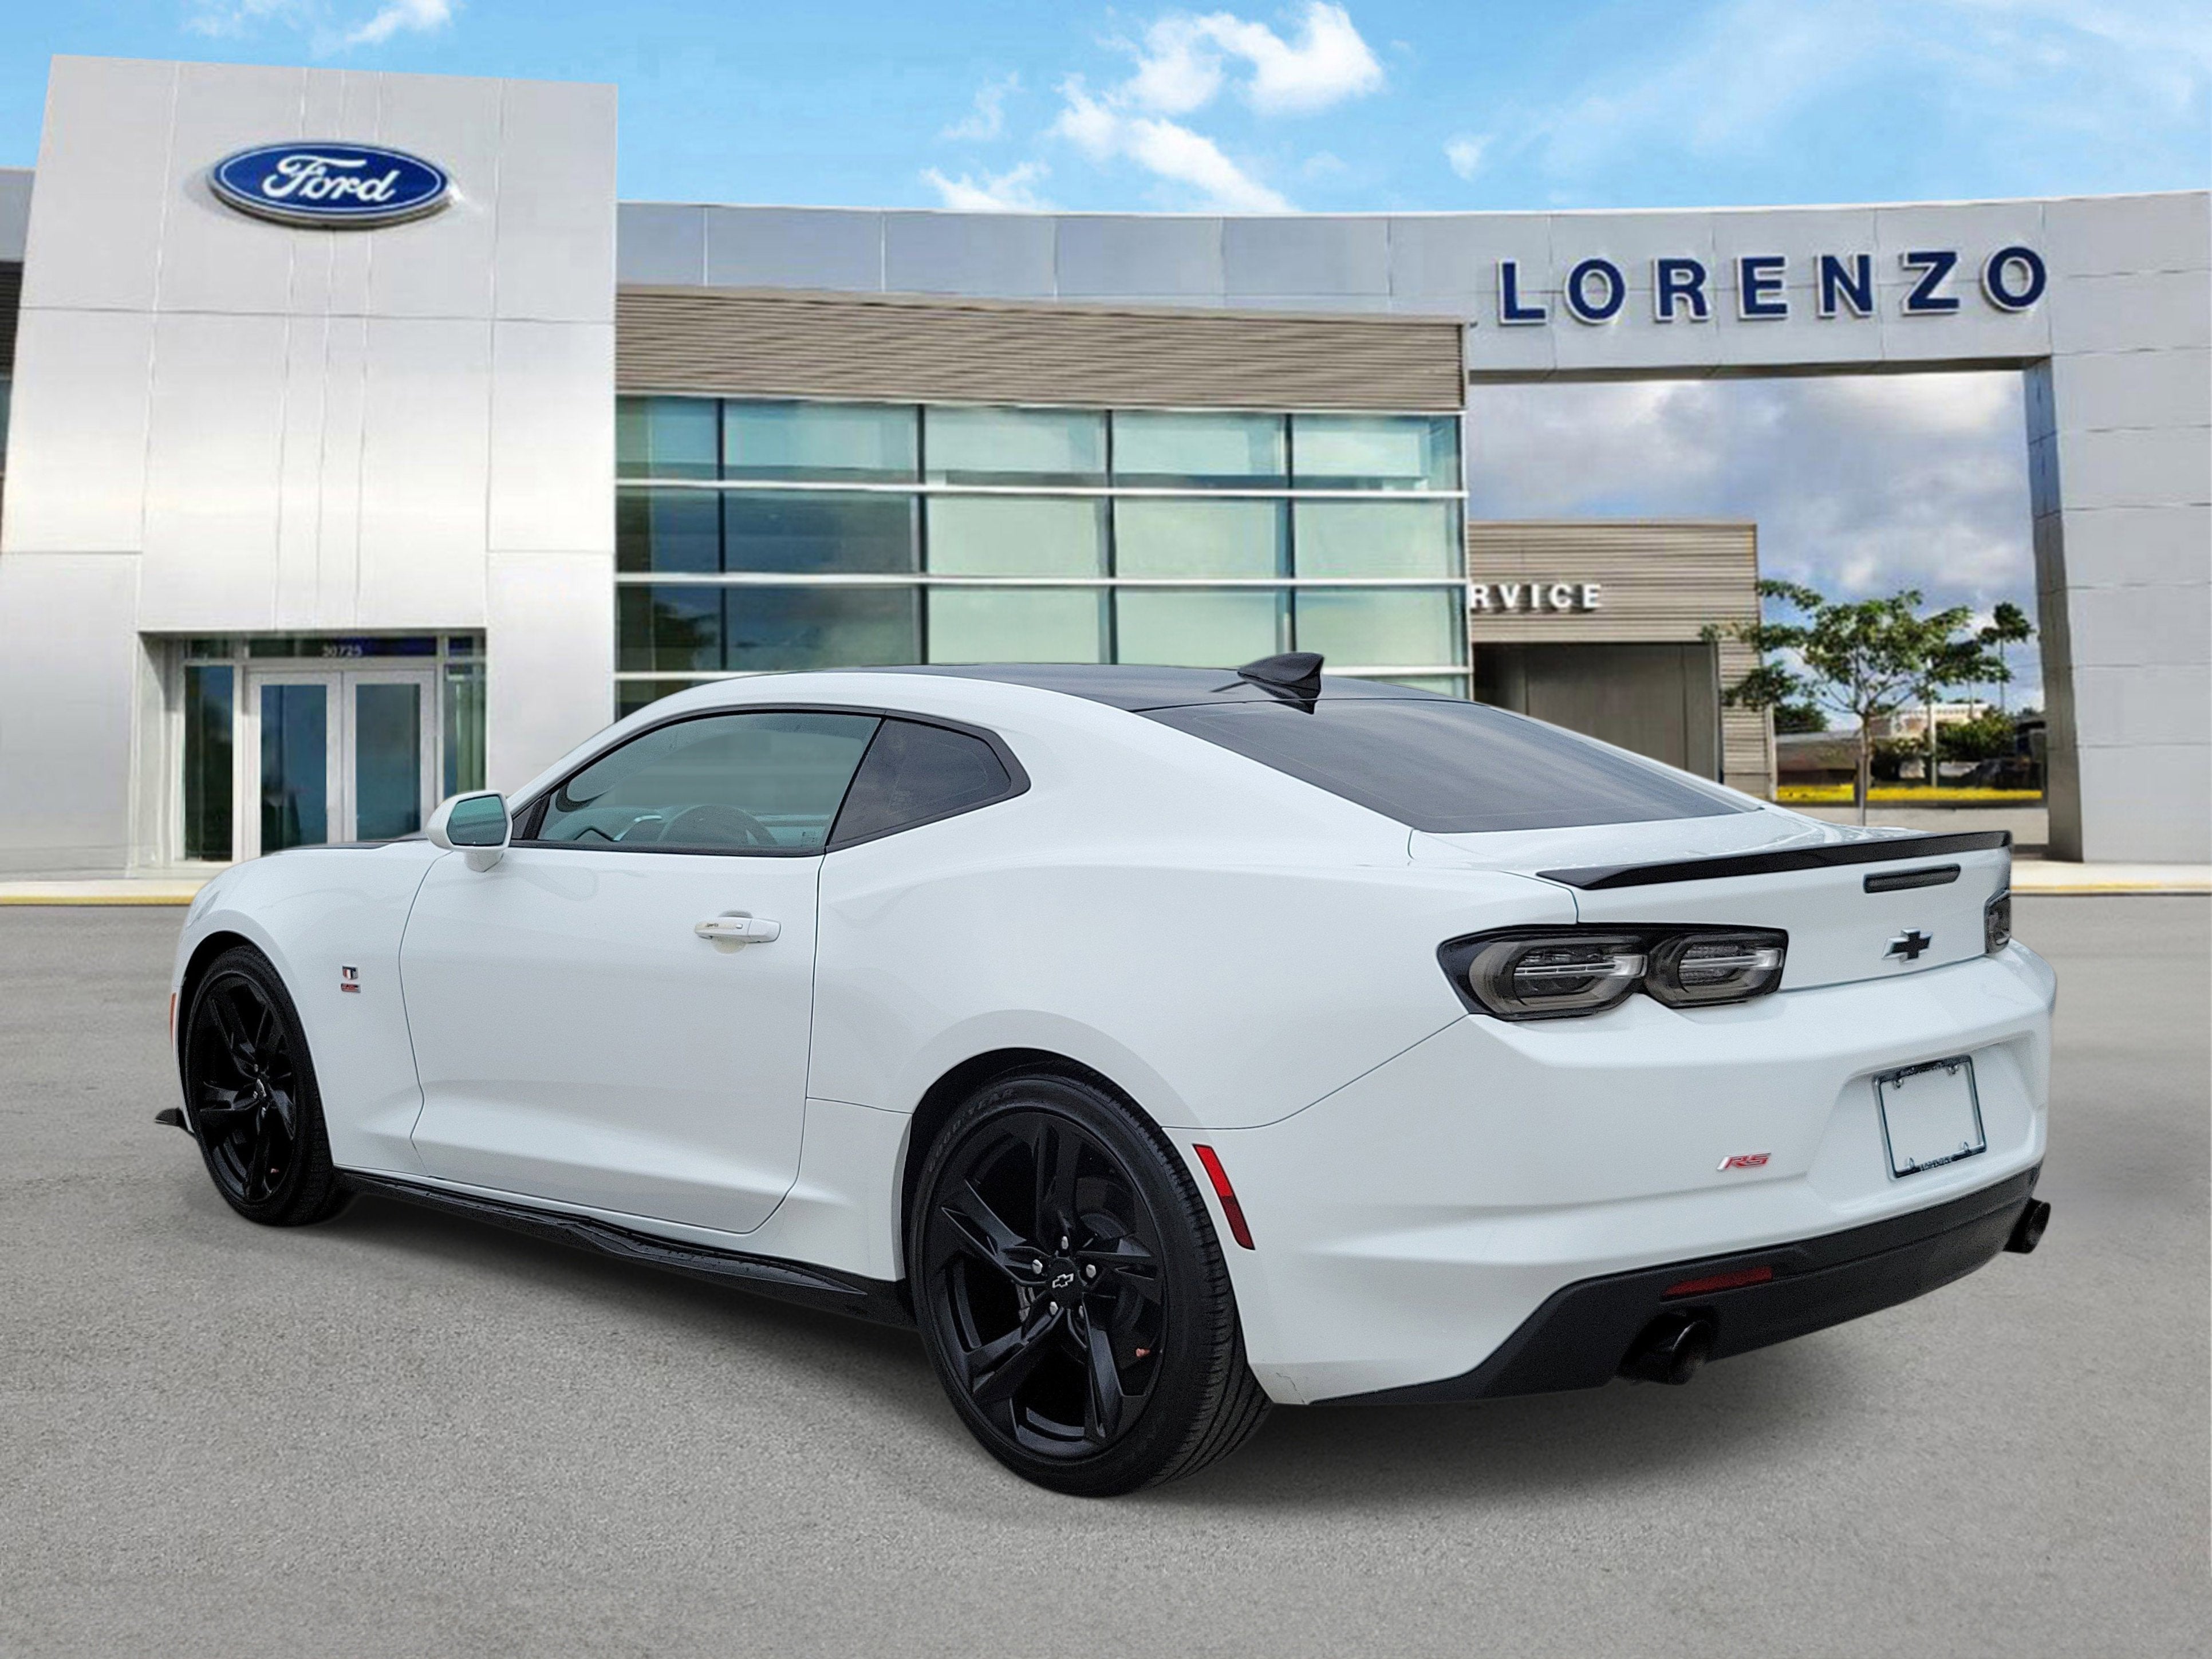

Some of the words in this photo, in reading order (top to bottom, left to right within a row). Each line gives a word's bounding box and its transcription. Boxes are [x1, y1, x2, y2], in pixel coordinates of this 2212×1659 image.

[262, 154, 401, 202] Ford
[1497, 245, 2048, 325] LORENZO
[1469, 584, 1602, 608] RVICE
[1717, 1152, 1772, 1171] RS
